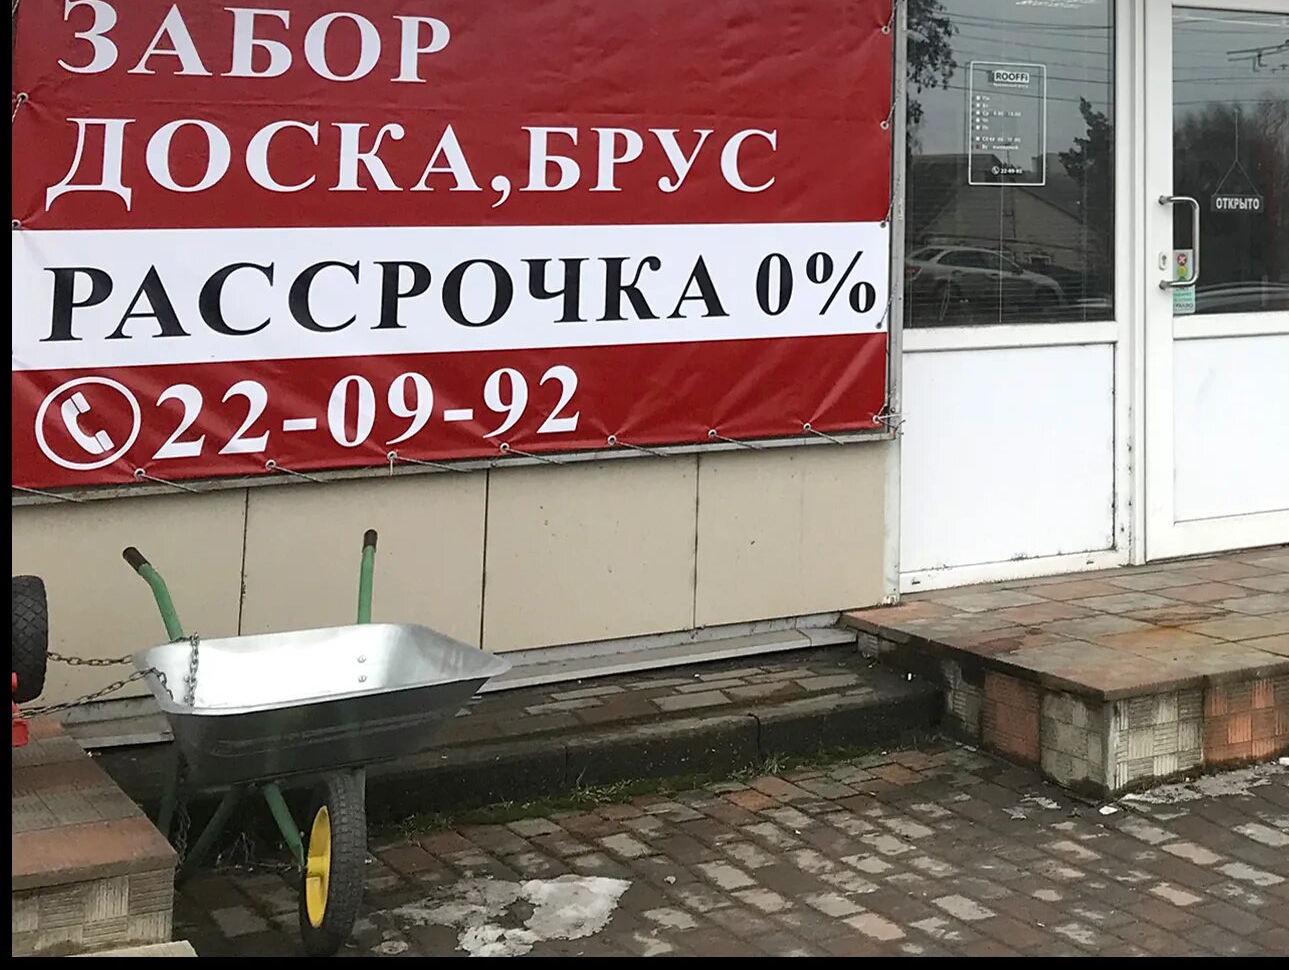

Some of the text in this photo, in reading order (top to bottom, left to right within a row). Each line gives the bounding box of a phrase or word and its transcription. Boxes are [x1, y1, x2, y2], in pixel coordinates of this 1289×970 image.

[1215, 196, 1260, 210] ОТКРЫТО
[39, 250, 877, 344] РАССРОЧКА 0%
[154, 365, 581, 460] 22-09-92
